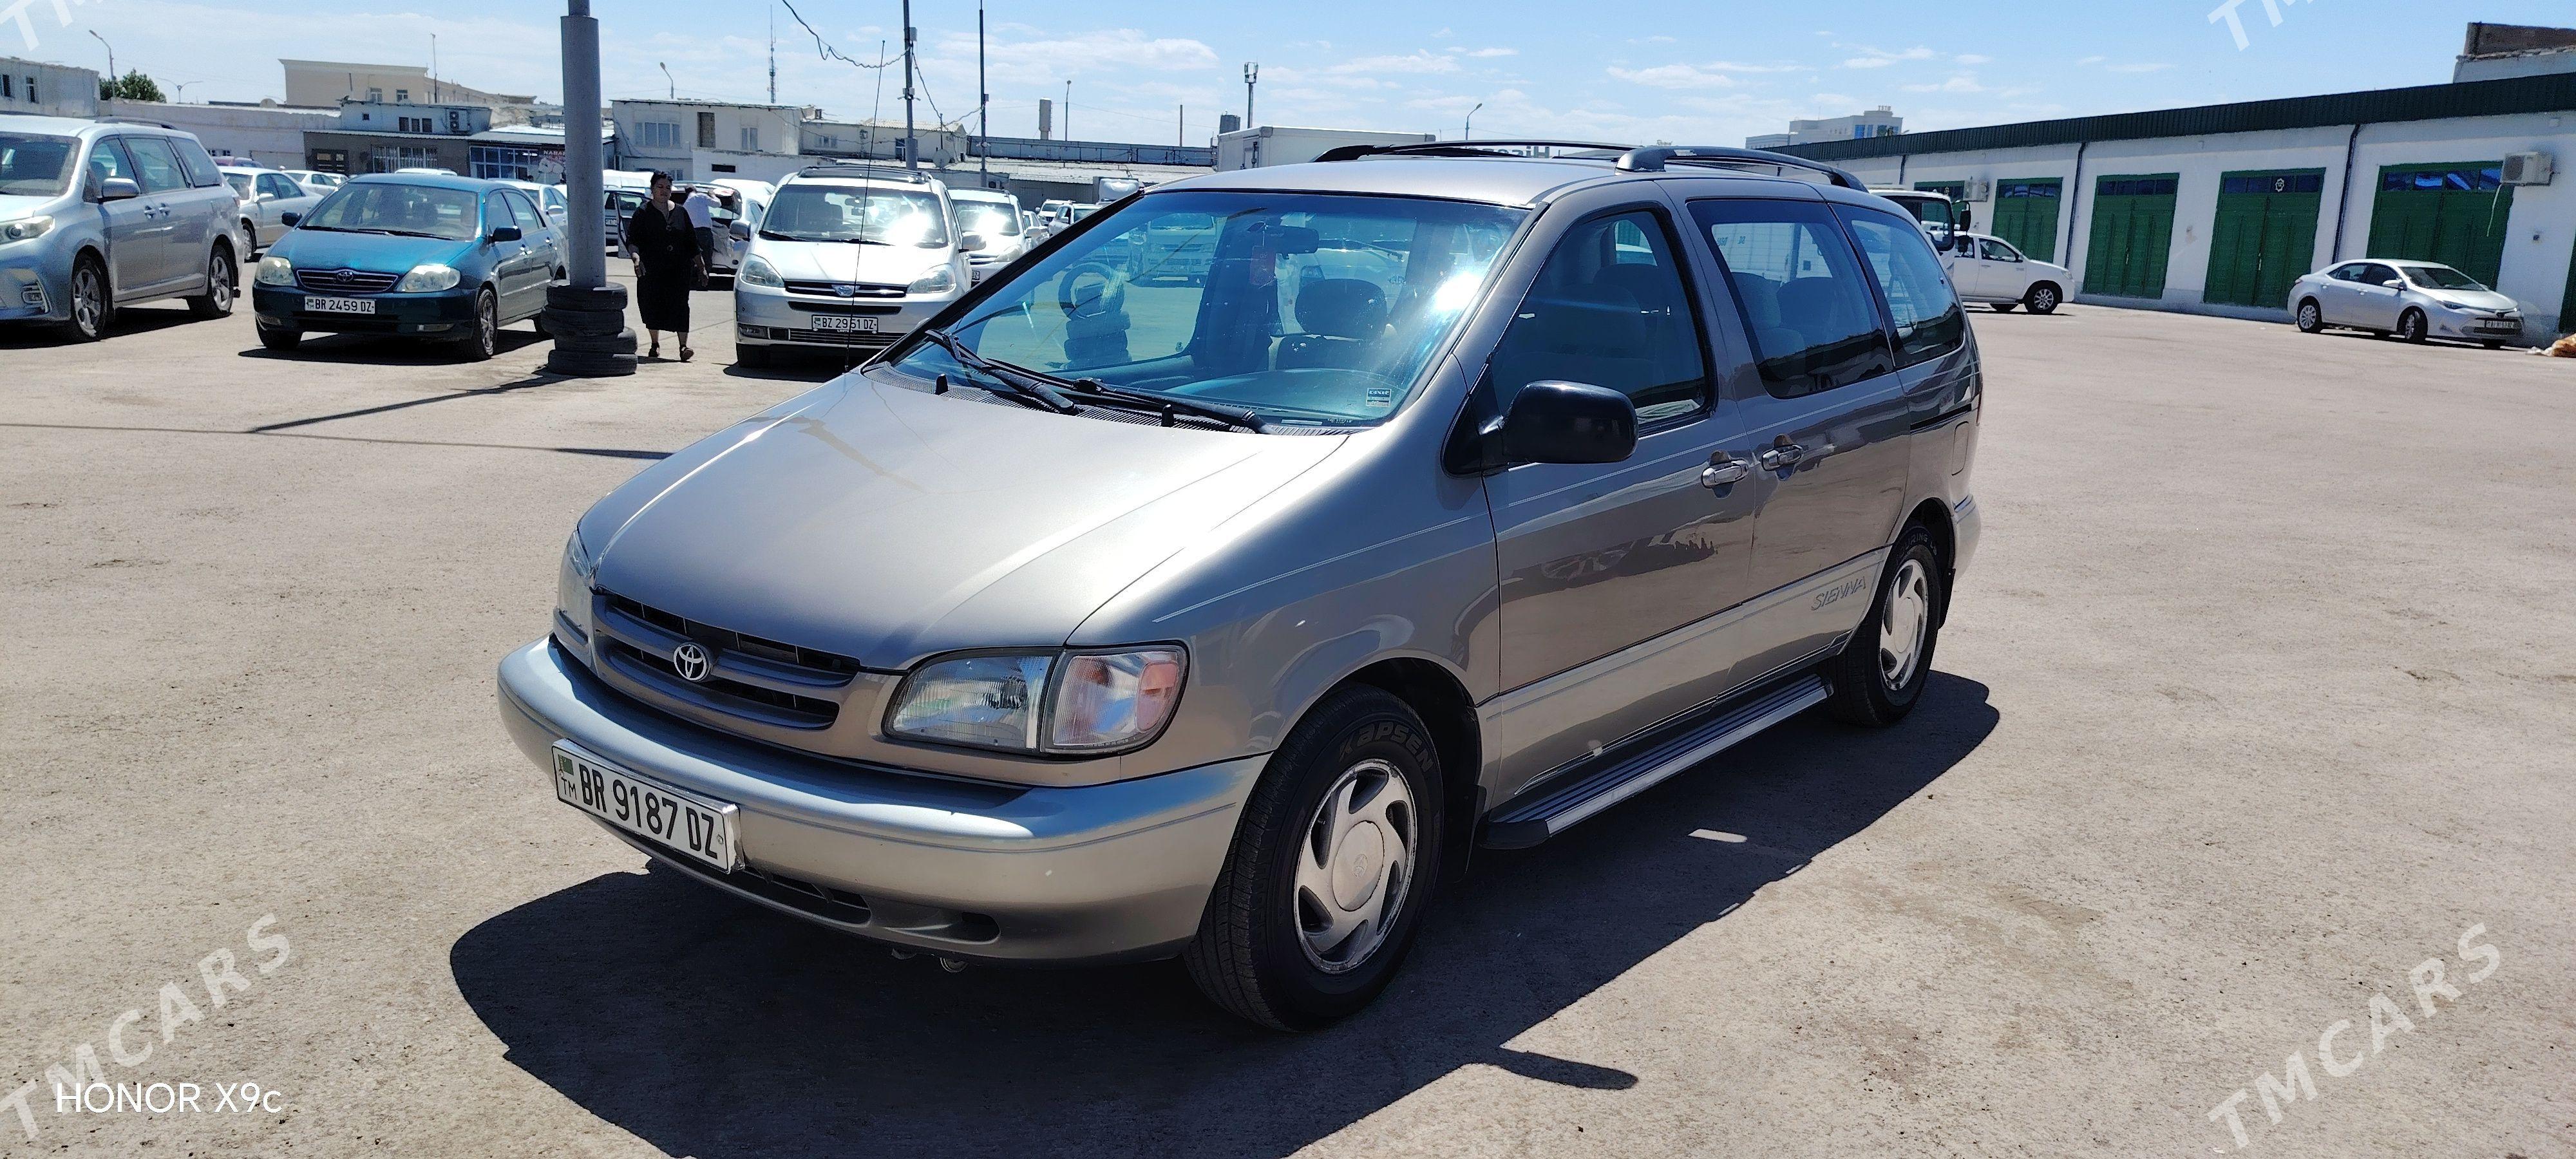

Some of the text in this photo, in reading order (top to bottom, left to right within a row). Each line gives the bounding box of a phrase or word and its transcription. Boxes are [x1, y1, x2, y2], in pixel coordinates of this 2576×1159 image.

[315, 299, 372, 312] BR 2459 DZ
[822, 317, 832, 328] BZ
[864, 319, 873, 329] DZ
[1811, 576, 1866, 611] SIENNA
[561, 777, 578, 800] TM
[578, 763, 718, 860] BR 9187 DZ
